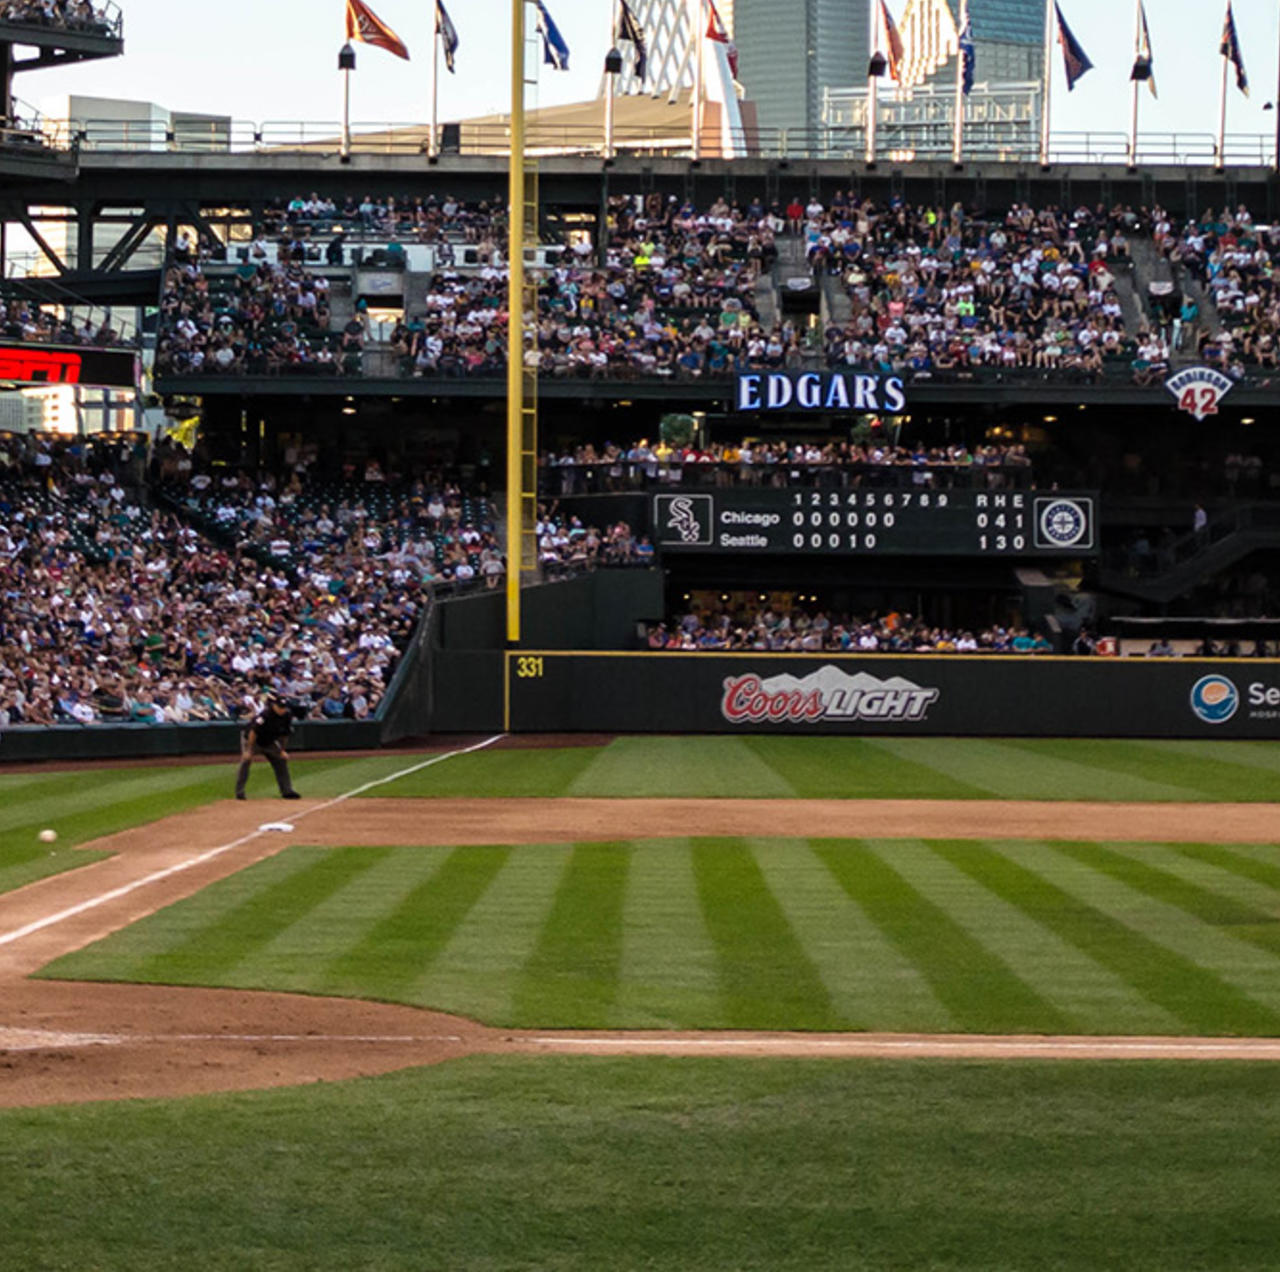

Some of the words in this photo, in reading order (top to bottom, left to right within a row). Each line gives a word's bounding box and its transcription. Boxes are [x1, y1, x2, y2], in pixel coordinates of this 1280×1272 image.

[1180, 387, 1218, 415] 42
[794, 494, 803, 507] 1
[811, 494, 821, 507] 2
[829, 494, 840, 507] 3
[847, 494, 858, 507] 4
[865, 494, 876, 507] 5
[883, 494, 894, 507] 6
[901, 494, 912, 507] 7
[919, 494, 929, 507] 8
[938, 494, 948, 507] 9
[976, 494, 988, 508] R
[995, 494, 1006, 508] H
[1013, 494, 1024, 508] E
[720, 511, 781, 527] Chicago
[793, 512, 804, 527] 0
[811, 512, 821, 527] 0
[829, 512, 840, 527] 0
[847, 512, 858, 527] 0
[866, 512, 877, 527] 0
[883, 512, 894, 527] 0
[977, 513, 988, 528] 0
[995, 513, 1006, 528] 4
[1015, 514, 1023, 528] 1
[720, 533, 768, 548] Seattle
[793, 533, 804, 548] 0
[811, 533, 821, 548] 0
[829, 533, 840, 548] 0
[849, 534, 857, 548] 1
[865, 533, 876, 548] 0
[980, 535, 987, 549] 1
[996, 535, 1006, 549] 3
[1013, 535, 1024, 550] 0
[517, 658, 544, 678] 331
[723, 673, 821, 723] Coors
[820, 687, 939, 721] LIGHT
